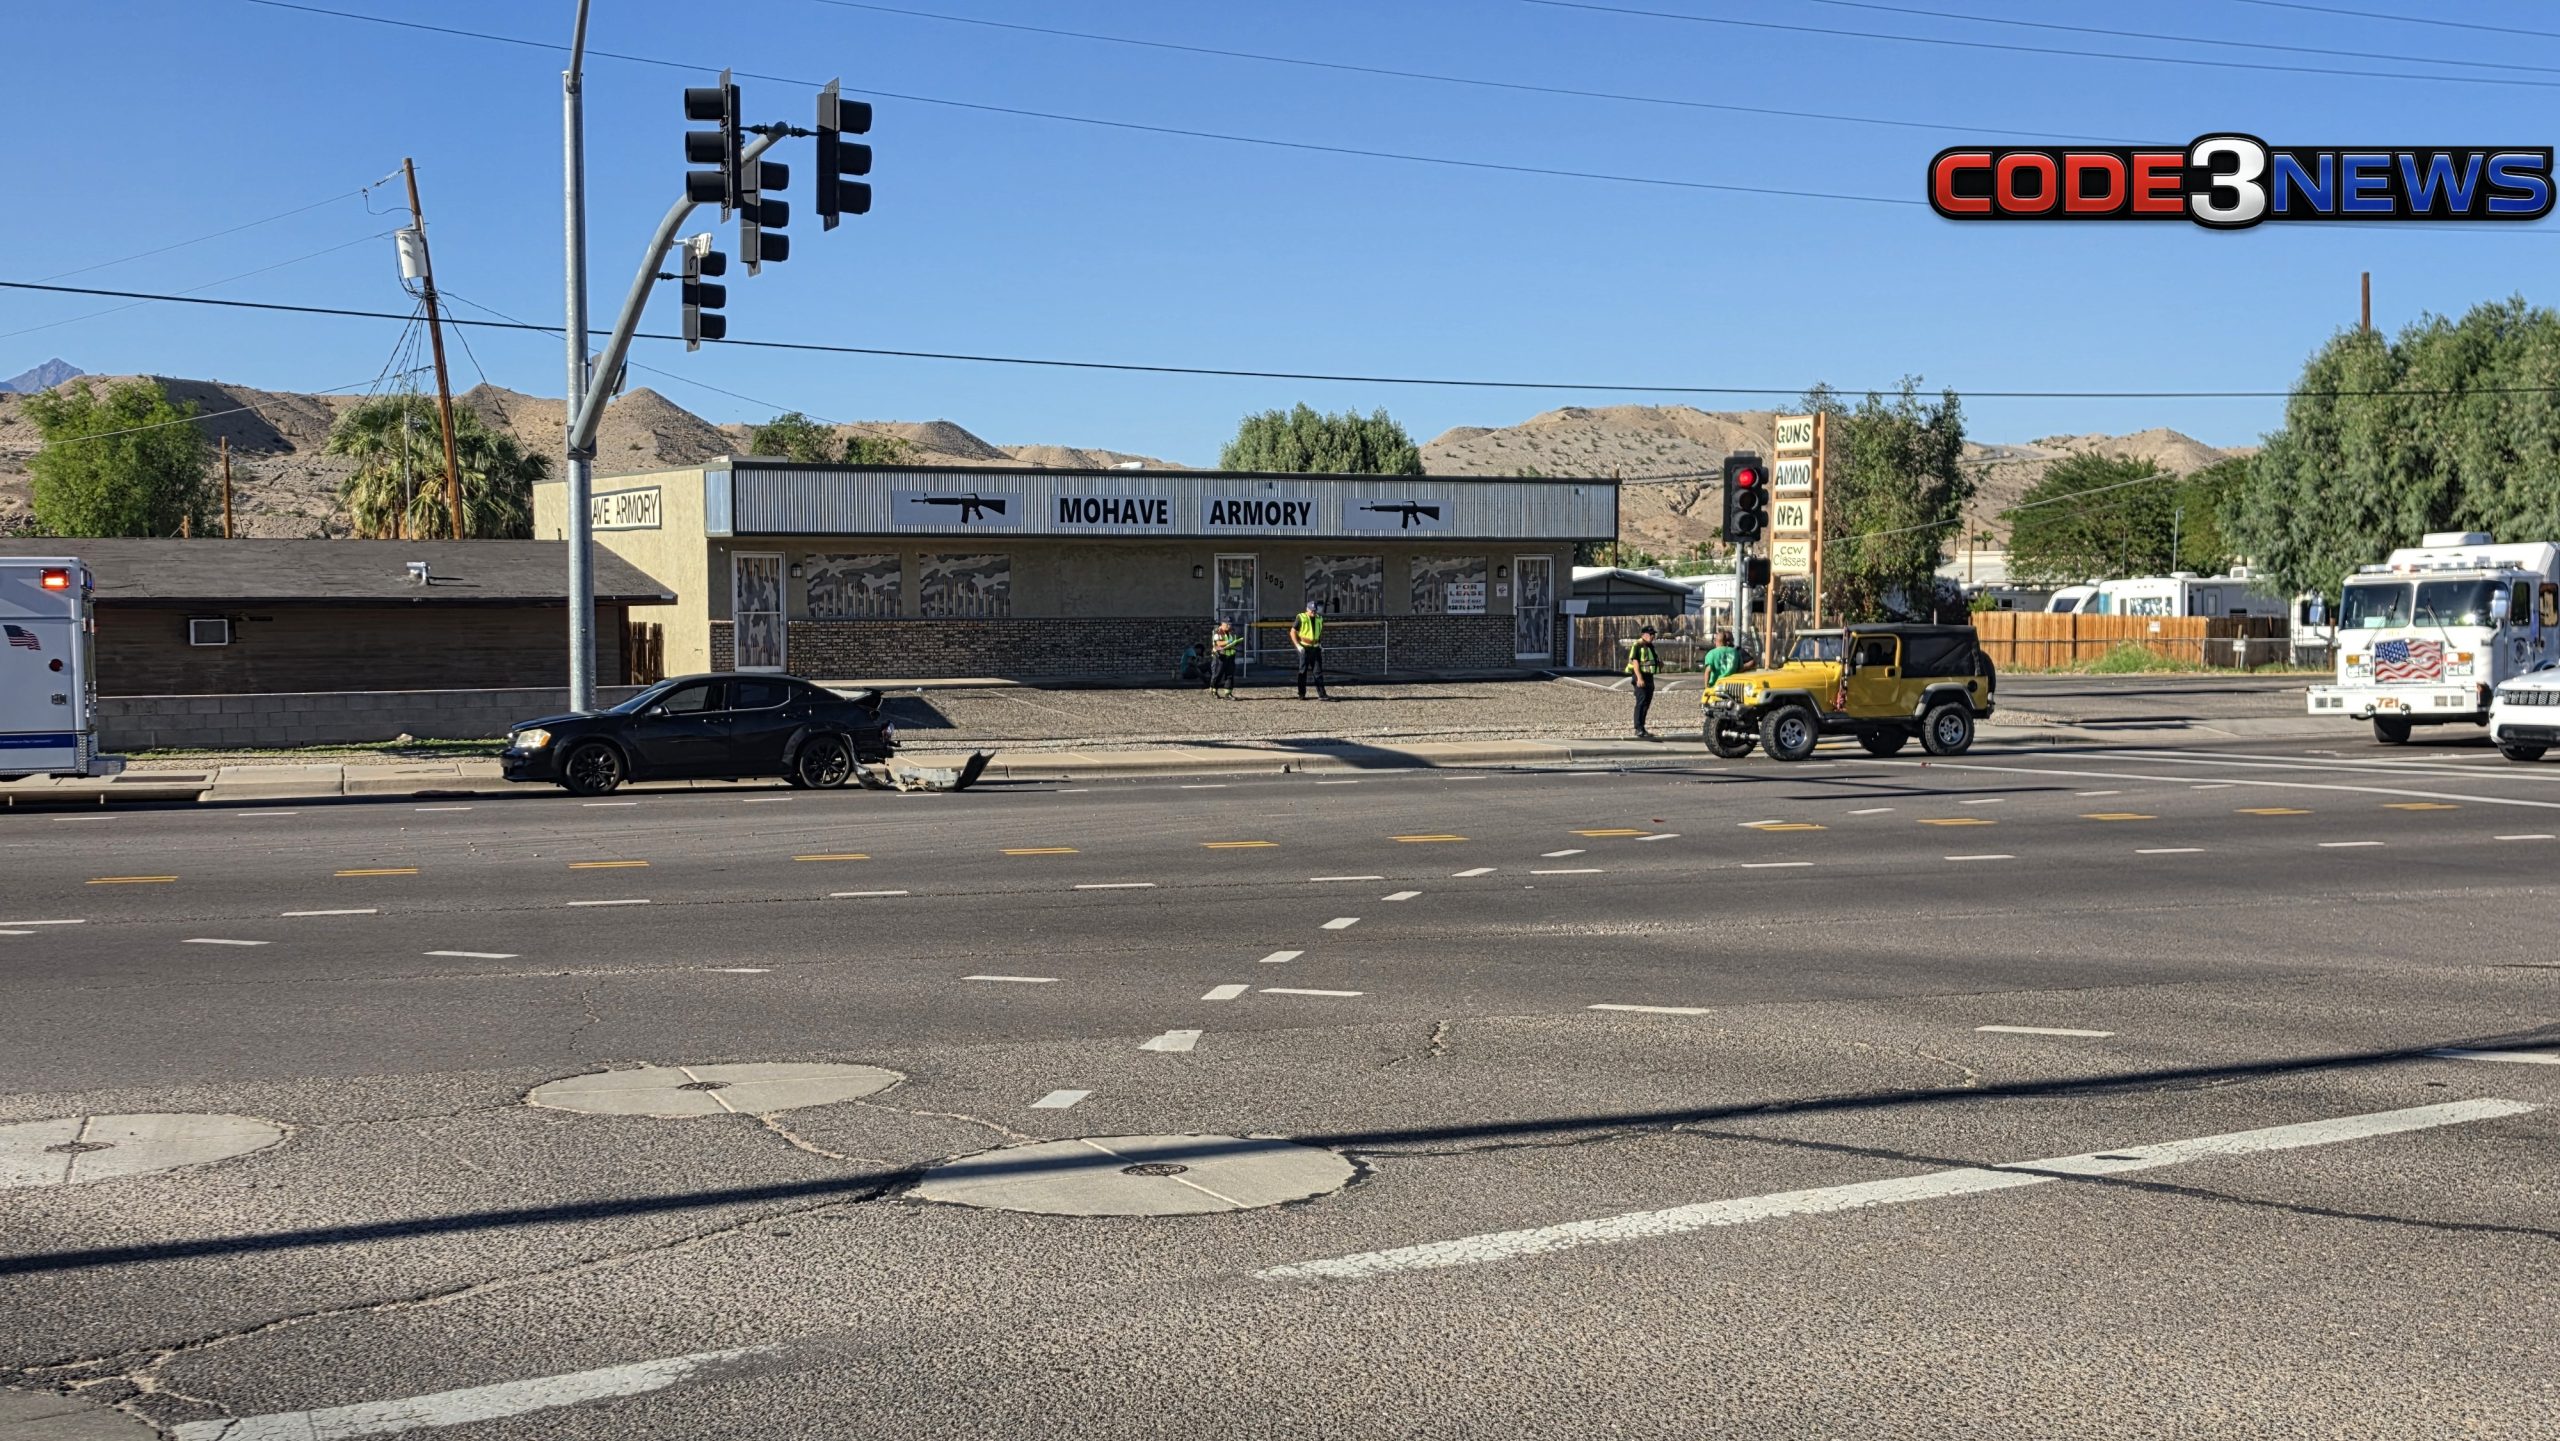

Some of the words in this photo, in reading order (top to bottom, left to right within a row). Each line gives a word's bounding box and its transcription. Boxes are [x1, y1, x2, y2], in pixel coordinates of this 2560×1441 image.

[1776, 423, 1811, 443] GUNS
[1775, 464, 1811, 486] AMMO
[616, 493, 658, 524] ARMORY
[1059, 497, 1168, 525] MOHAVE
[1209, 500, 1312, 526] ARMORY
[1777, 505, 1803, 526] NFA
[1773, 554, 1807, 567] Classes
[2376, 697, 2399, 708] 721
